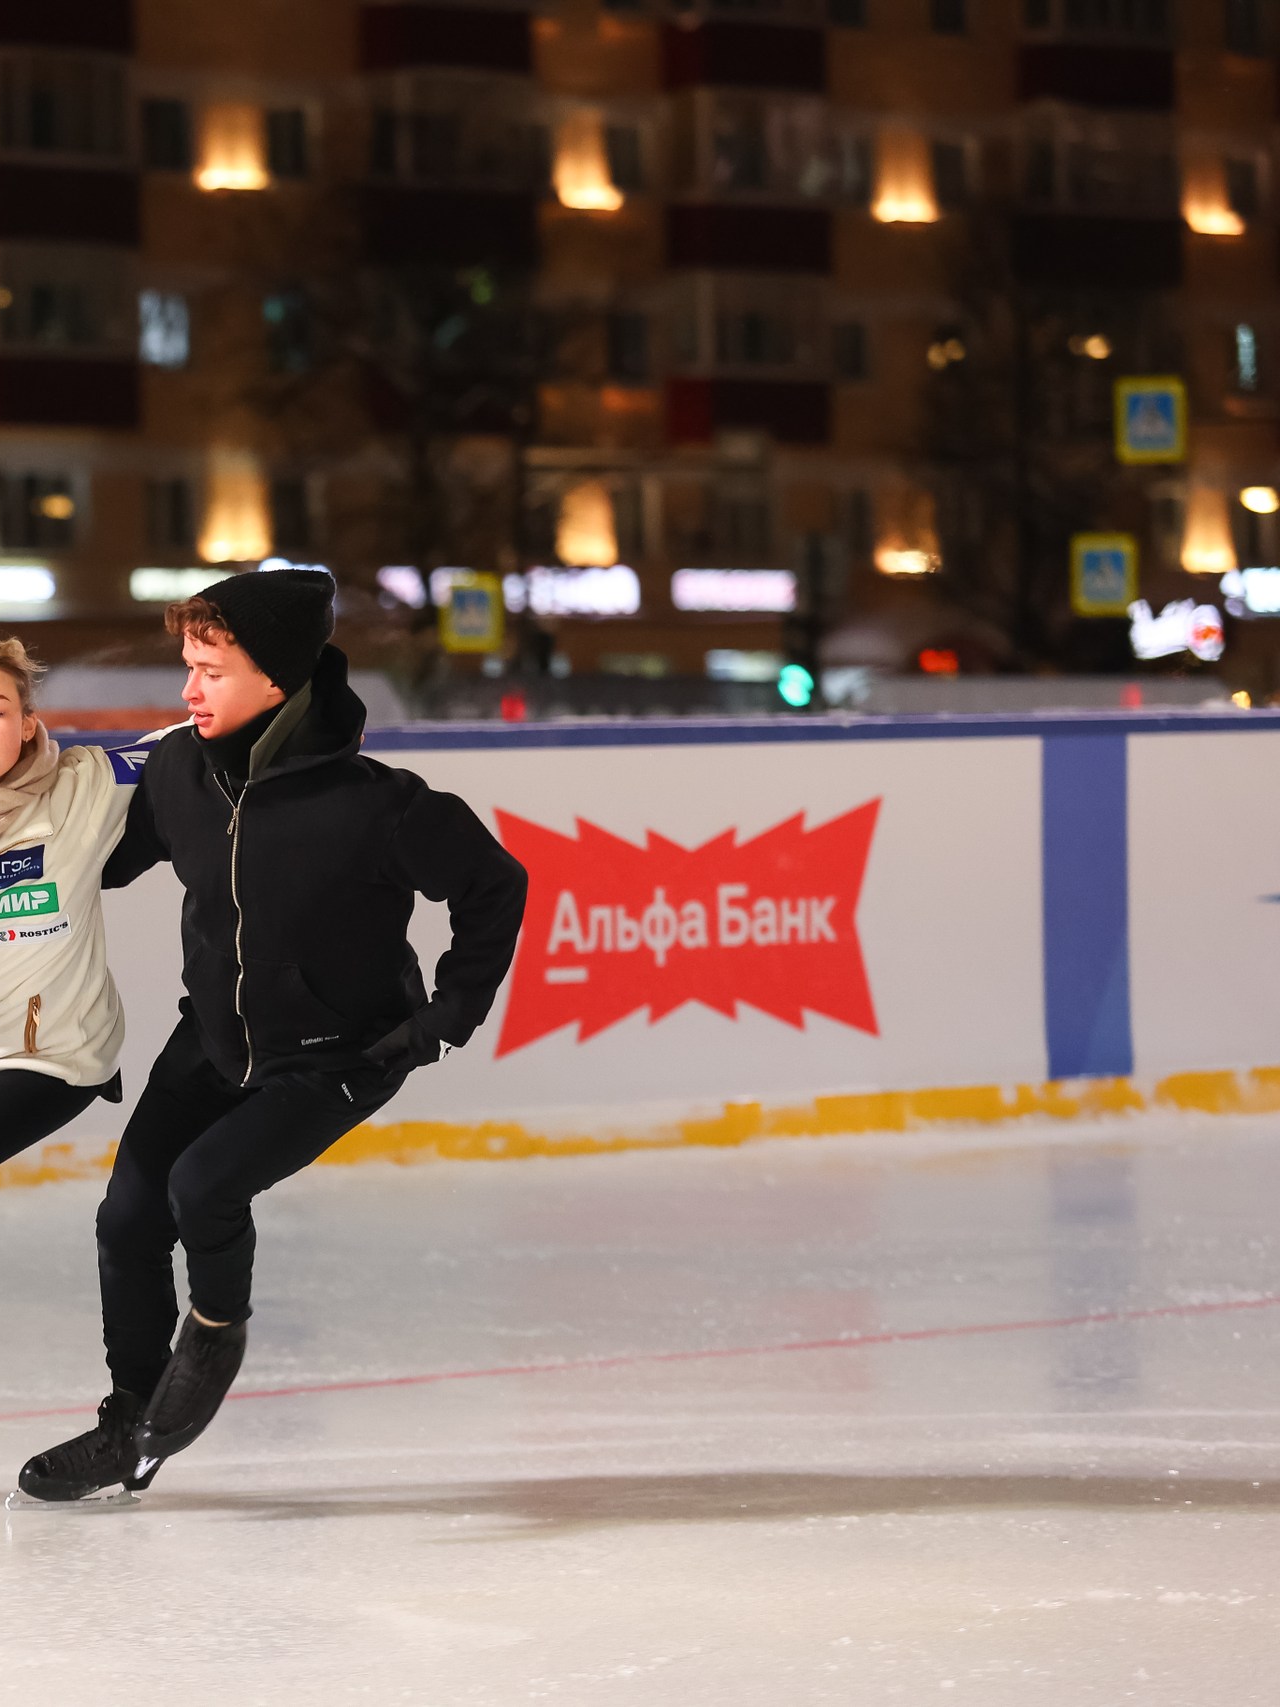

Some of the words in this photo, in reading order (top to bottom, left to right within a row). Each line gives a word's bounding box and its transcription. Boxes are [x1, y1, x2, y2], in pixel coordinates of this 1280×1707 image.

[1, 856, 32, 874] ГЭС
[19, 921, 69, 938] ROSTIC'S
[547, 887, 709, 968] Альфа
[717, 883, 837, 947] Банк
